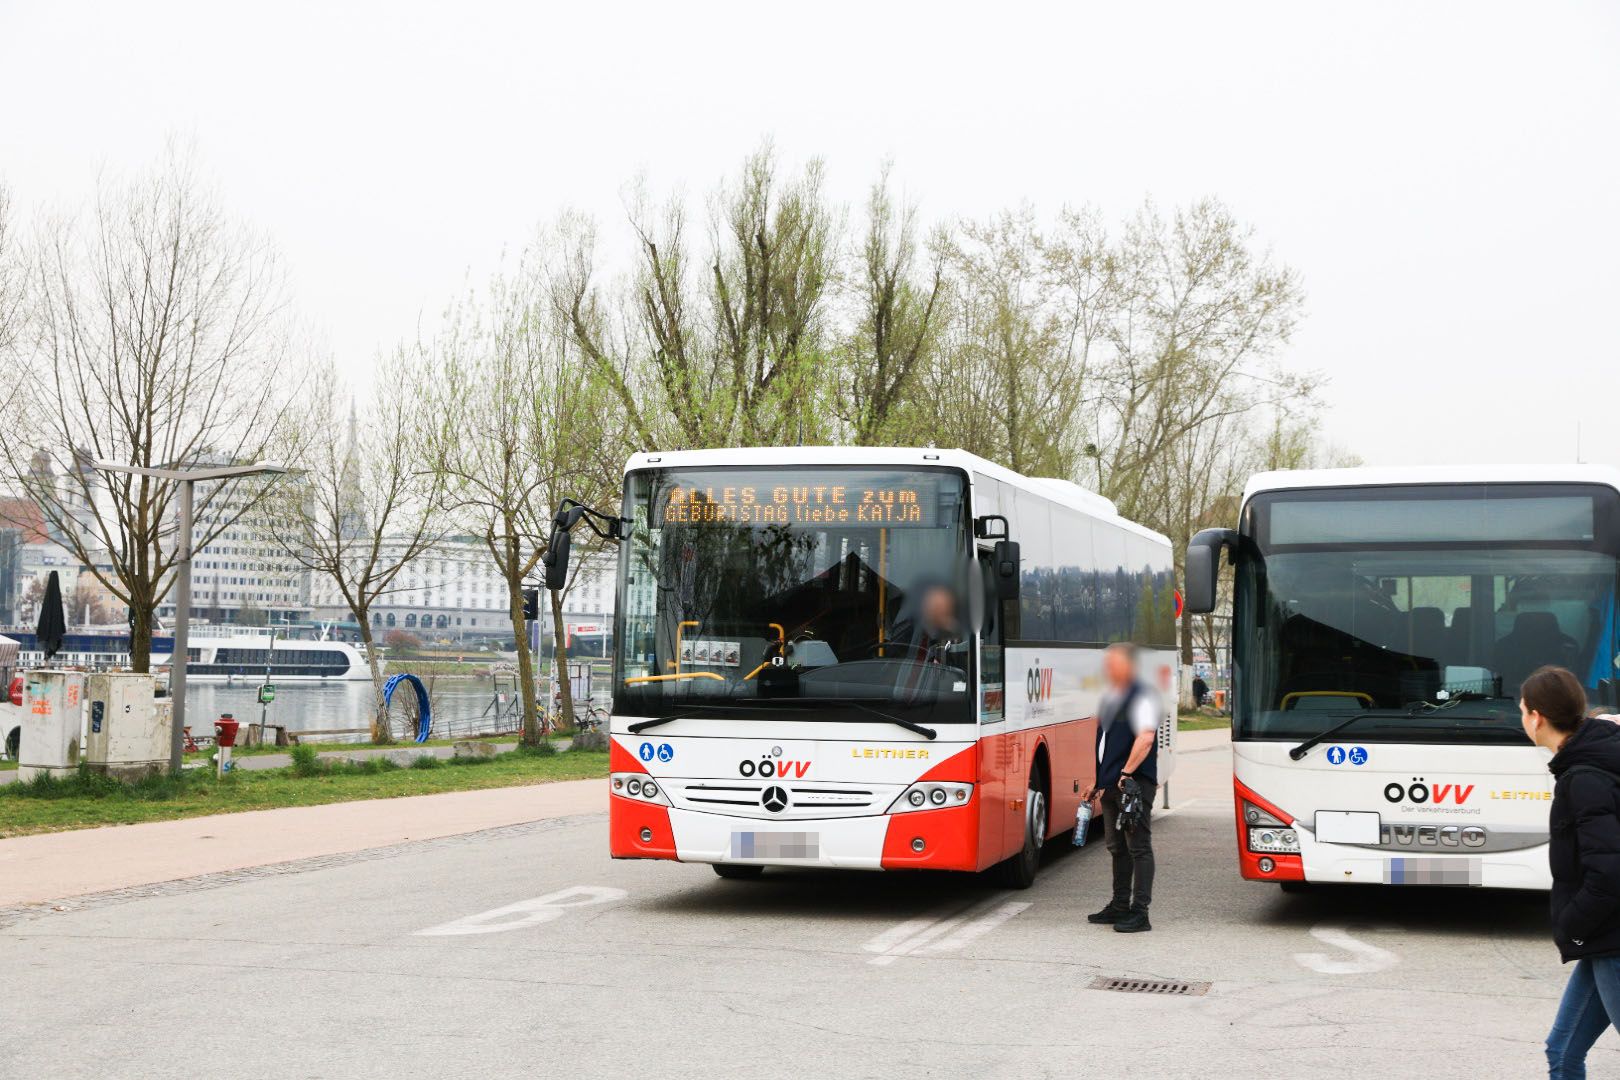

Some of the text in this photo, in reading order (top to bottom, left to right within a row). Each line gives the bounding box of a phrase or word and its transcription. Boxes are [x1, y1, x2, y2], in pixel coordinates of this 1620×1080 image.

[671, 487, 916, 503] ALLES GUTE zum
[666, 504, 920, 521] GEBURTSTAG liebe KATJA
[852, 748, 929, 759] LEITNER
[739, 754, 812, 779] OÖVV
[1384, 777, 1475, 805] OÖVV
[1490, 790, 1552, 801] LEITNE
[1382, 824, 1487, 848] IVECO
